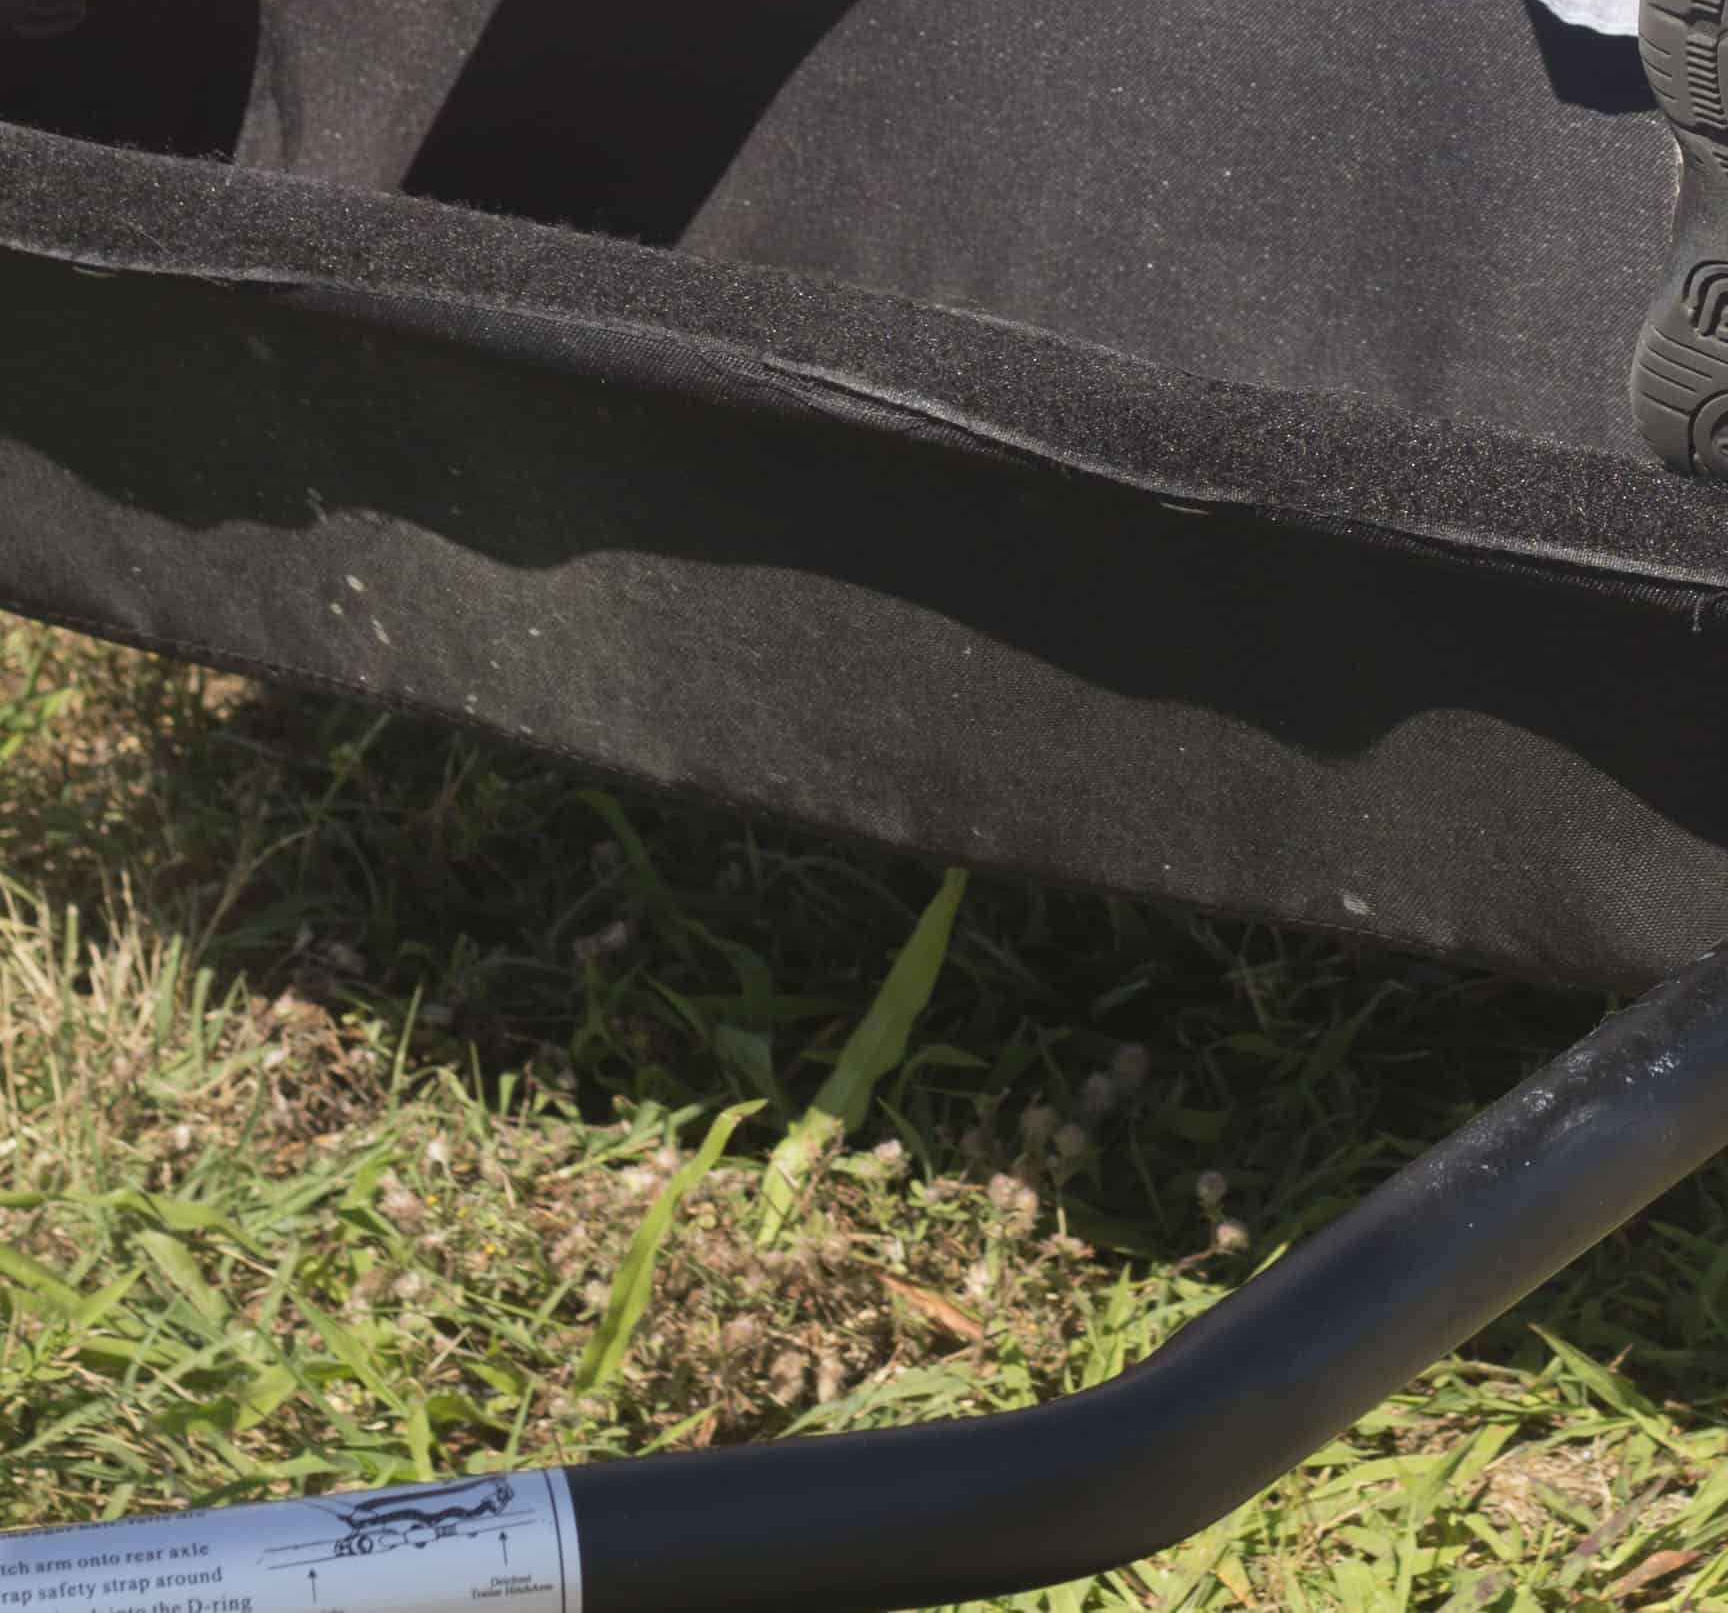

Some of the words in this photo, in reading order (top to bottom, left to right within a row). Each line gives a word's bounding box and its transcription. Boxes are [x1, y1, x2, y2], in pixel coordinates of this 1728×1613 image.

[35, 1558, 73, 1573] arm
[77, 1552, 121, 1569] onto
[125, 1547, 163, 1564] rear
[169, 1542, 210, 1560] axle
[1, 1589, 33, 1608] rap
[38, 1580, 98, 1601] safety
[102, 1577, 150, 1595] strap
[155, 1565, 223, 1589] around
